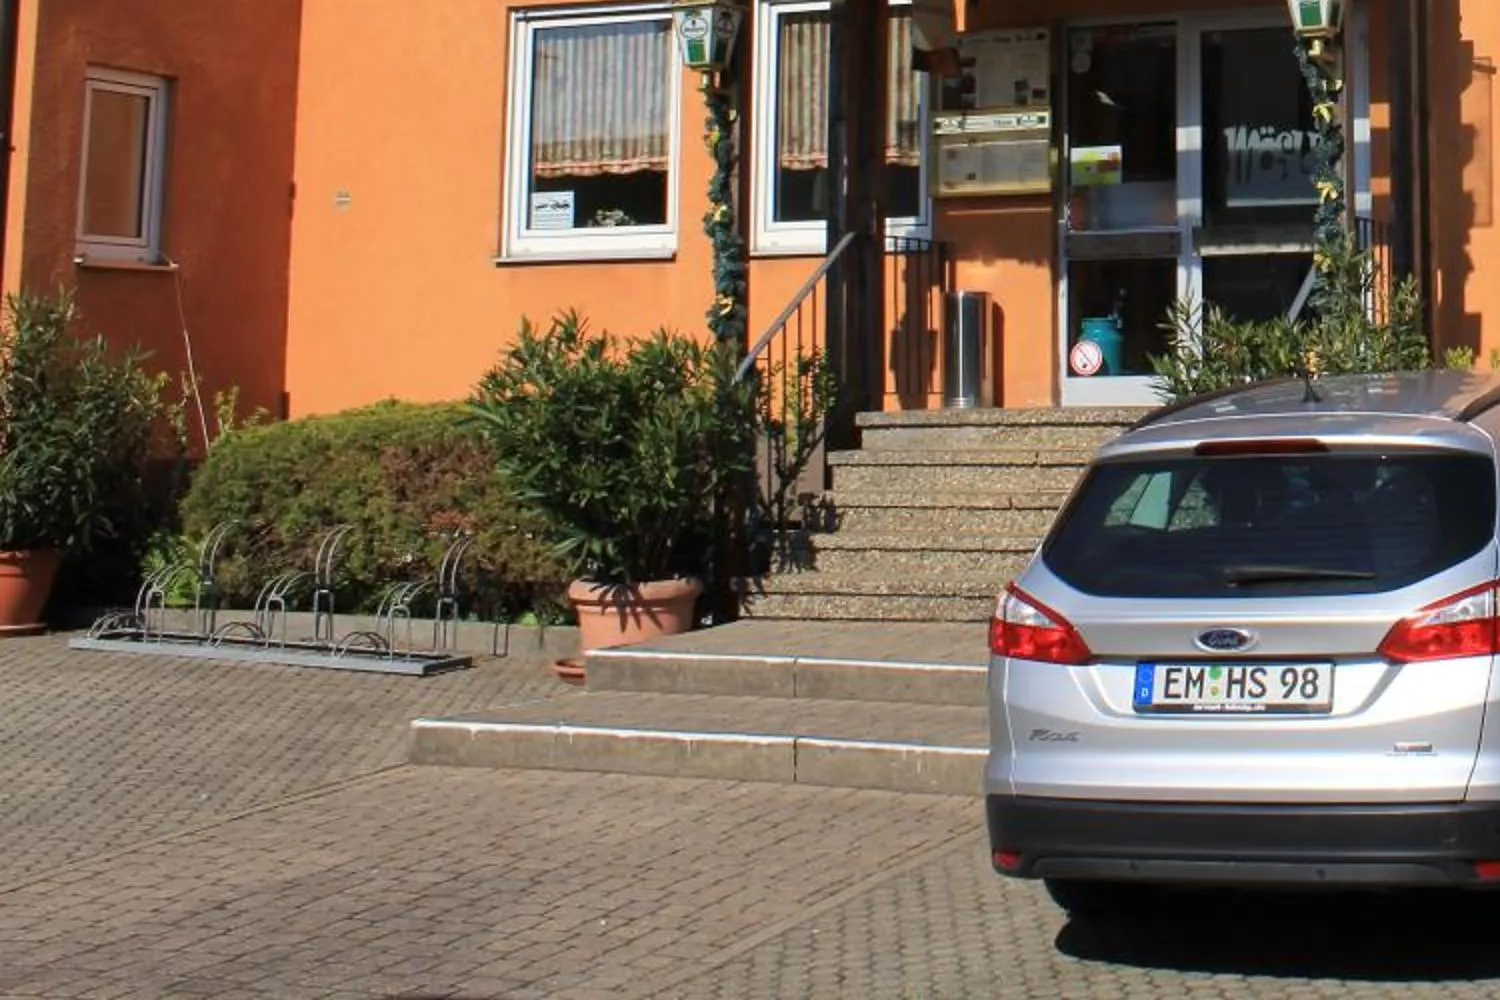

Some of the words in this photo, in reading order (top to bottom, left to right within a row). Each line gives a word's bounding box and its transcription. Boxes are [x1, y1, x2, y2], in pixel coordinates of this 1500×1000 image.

[1163, 667, 1205, 699] EM
[1226, 667, 1268, 699] HS
[1280, 667, 1319, 699] 98
